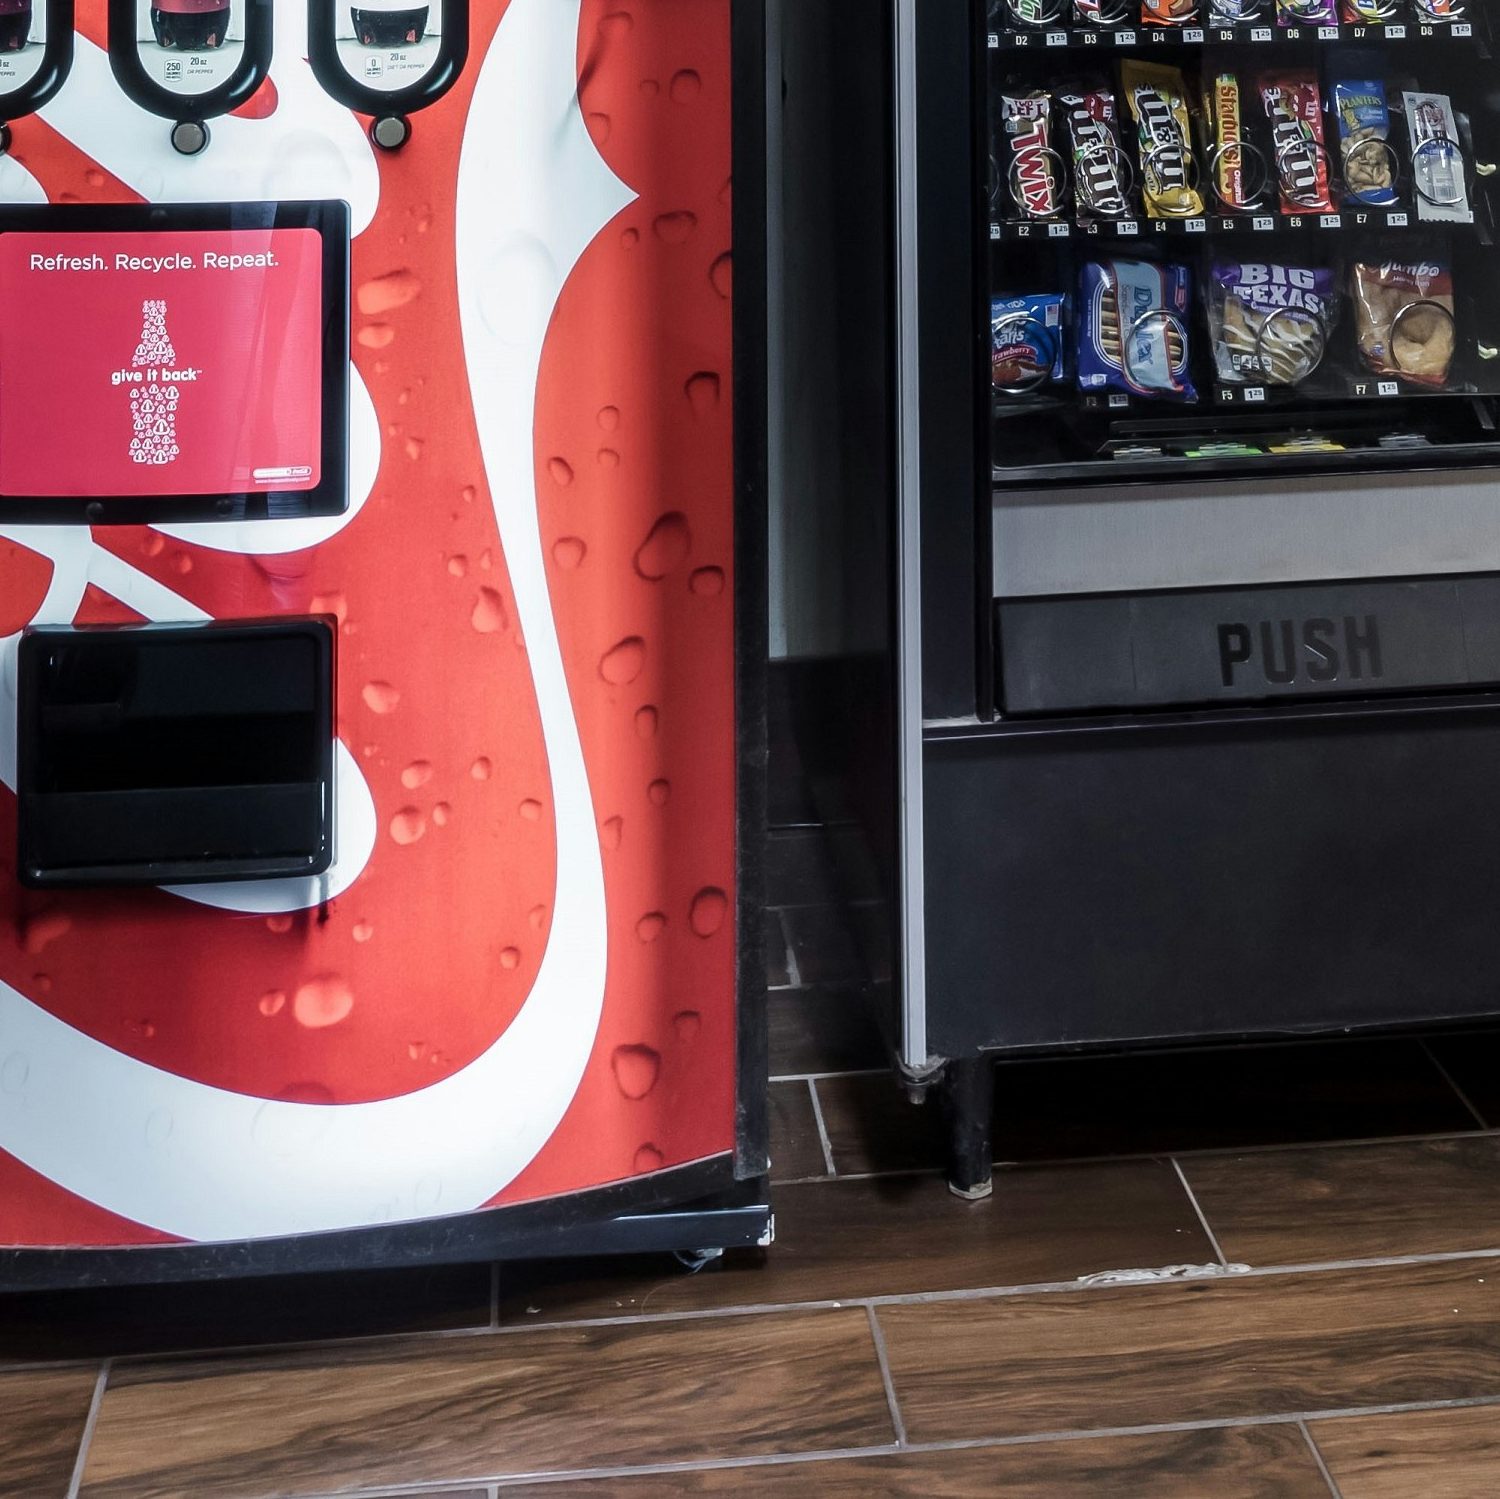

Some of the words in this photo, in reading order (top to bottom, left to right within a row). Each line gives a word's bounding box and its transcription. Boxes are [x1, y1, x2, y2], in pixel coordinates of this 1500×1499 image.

[1220, 30, 1233, 40] D5
[1287, 29, 1299, 39] D6
[1354, 28, 1366, 37] D7
[1421, 26, 1433, 35] D8
[1016, 36, 1028, 45] D2
[1084, 34, 1097, 43] D3
[1153, 32, 1165, 42] D4
[190, 57, 199, 66] 20
[390, 53, 399, 61] 20
[166, 62, 181, 71] 250
[371, 58, 377, 67] 0
[1339, 95, 1382, 110] PLANTERS
[1220, 85, 1241, 174] Starbust
[1223, 219, 1234, 229] E5
[1290, 218, 1301, 227] E6
[1357, 214, 1367, 224] E7
[1019, 226, 1029, 236] E2
[1155, 222, 1166, 231] E4
[30, 253, 109, 271] Refresh.
[115, 252, 197, 274] Recycle.
[203, 250, 279, 271] Repeat.
[1380, 260, 1440, 277] Jumbo
[1240, 263, 1315, 290] BIG
[1233, 285, 1320, 314] TEXAS
[1129, 286, 1154, 366] Dulex
[111, 369, 143, 385] give
[147, 367, 158, 382] it
[1222, 390, 1233, 400] F5
[1356, 385, 1366, 395] F7
[1217, 614, 1385, 688] PUSH
